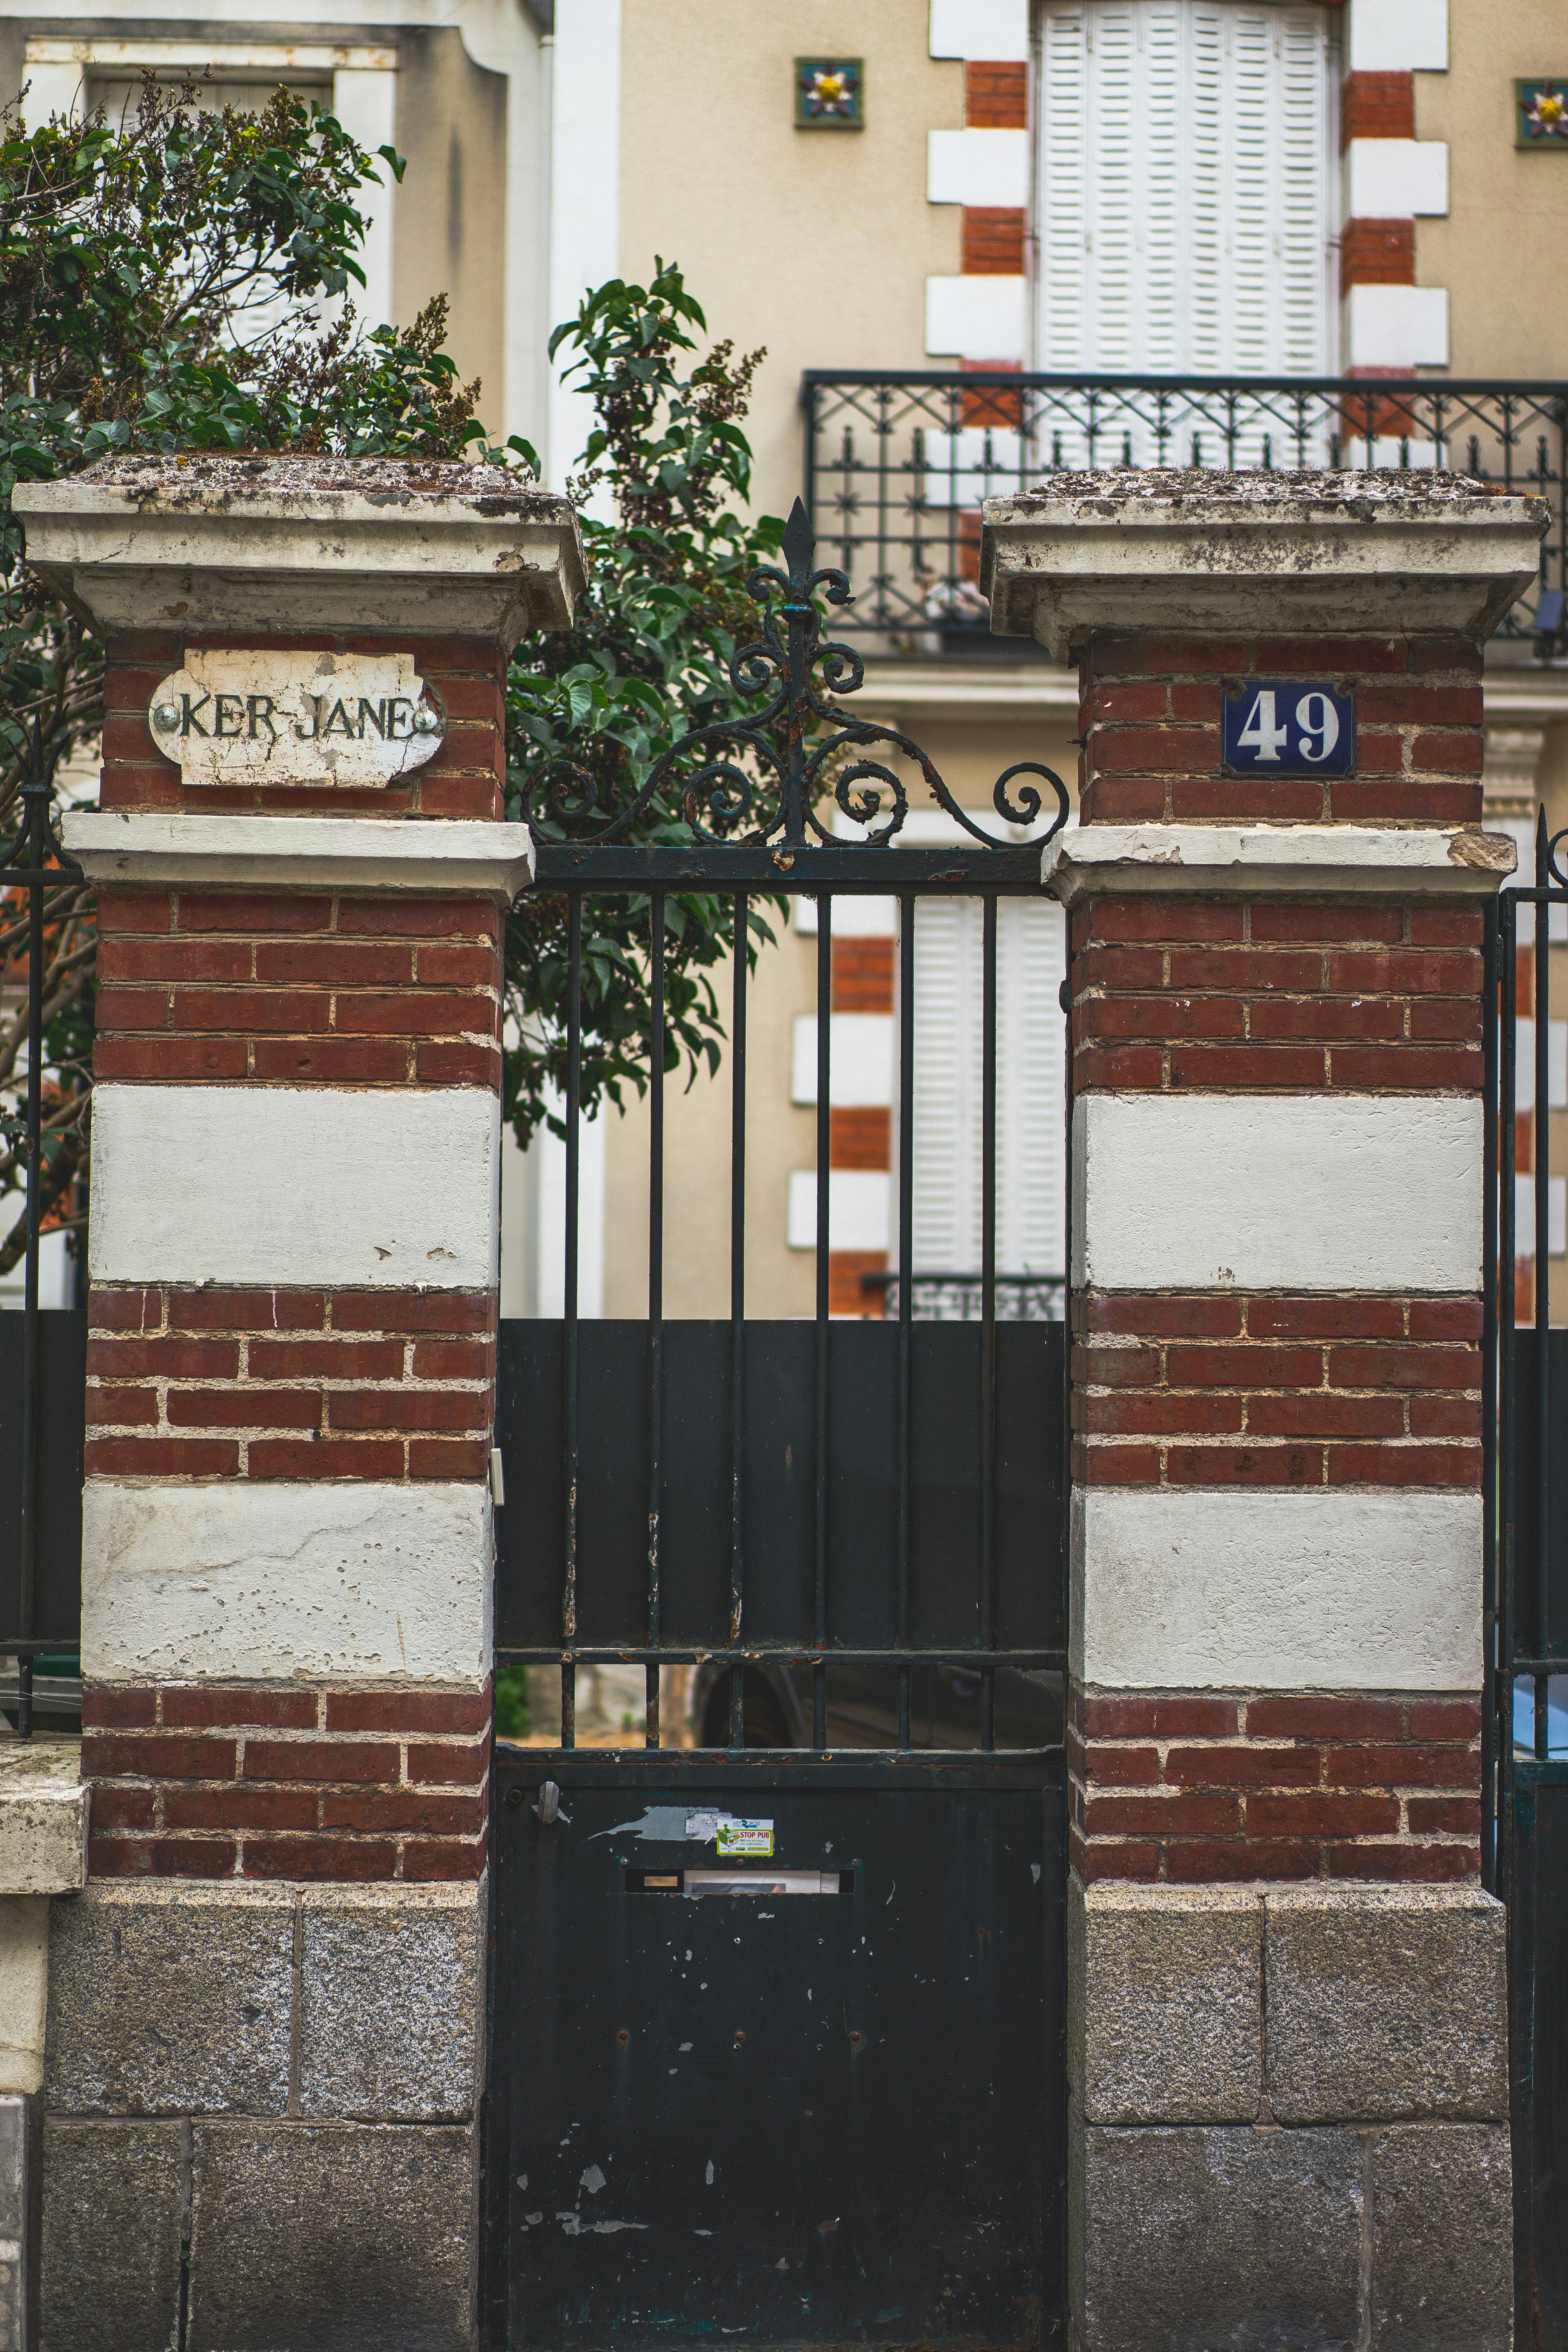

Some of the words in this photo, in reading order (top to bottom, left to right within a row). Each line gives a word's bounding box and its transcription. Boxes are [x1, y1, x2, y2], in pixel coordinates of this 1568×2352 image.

[180, 693, 278, 738] KER
[294, 696, 416, 741] JANE
[1237, 691, 1339, 762] 49
